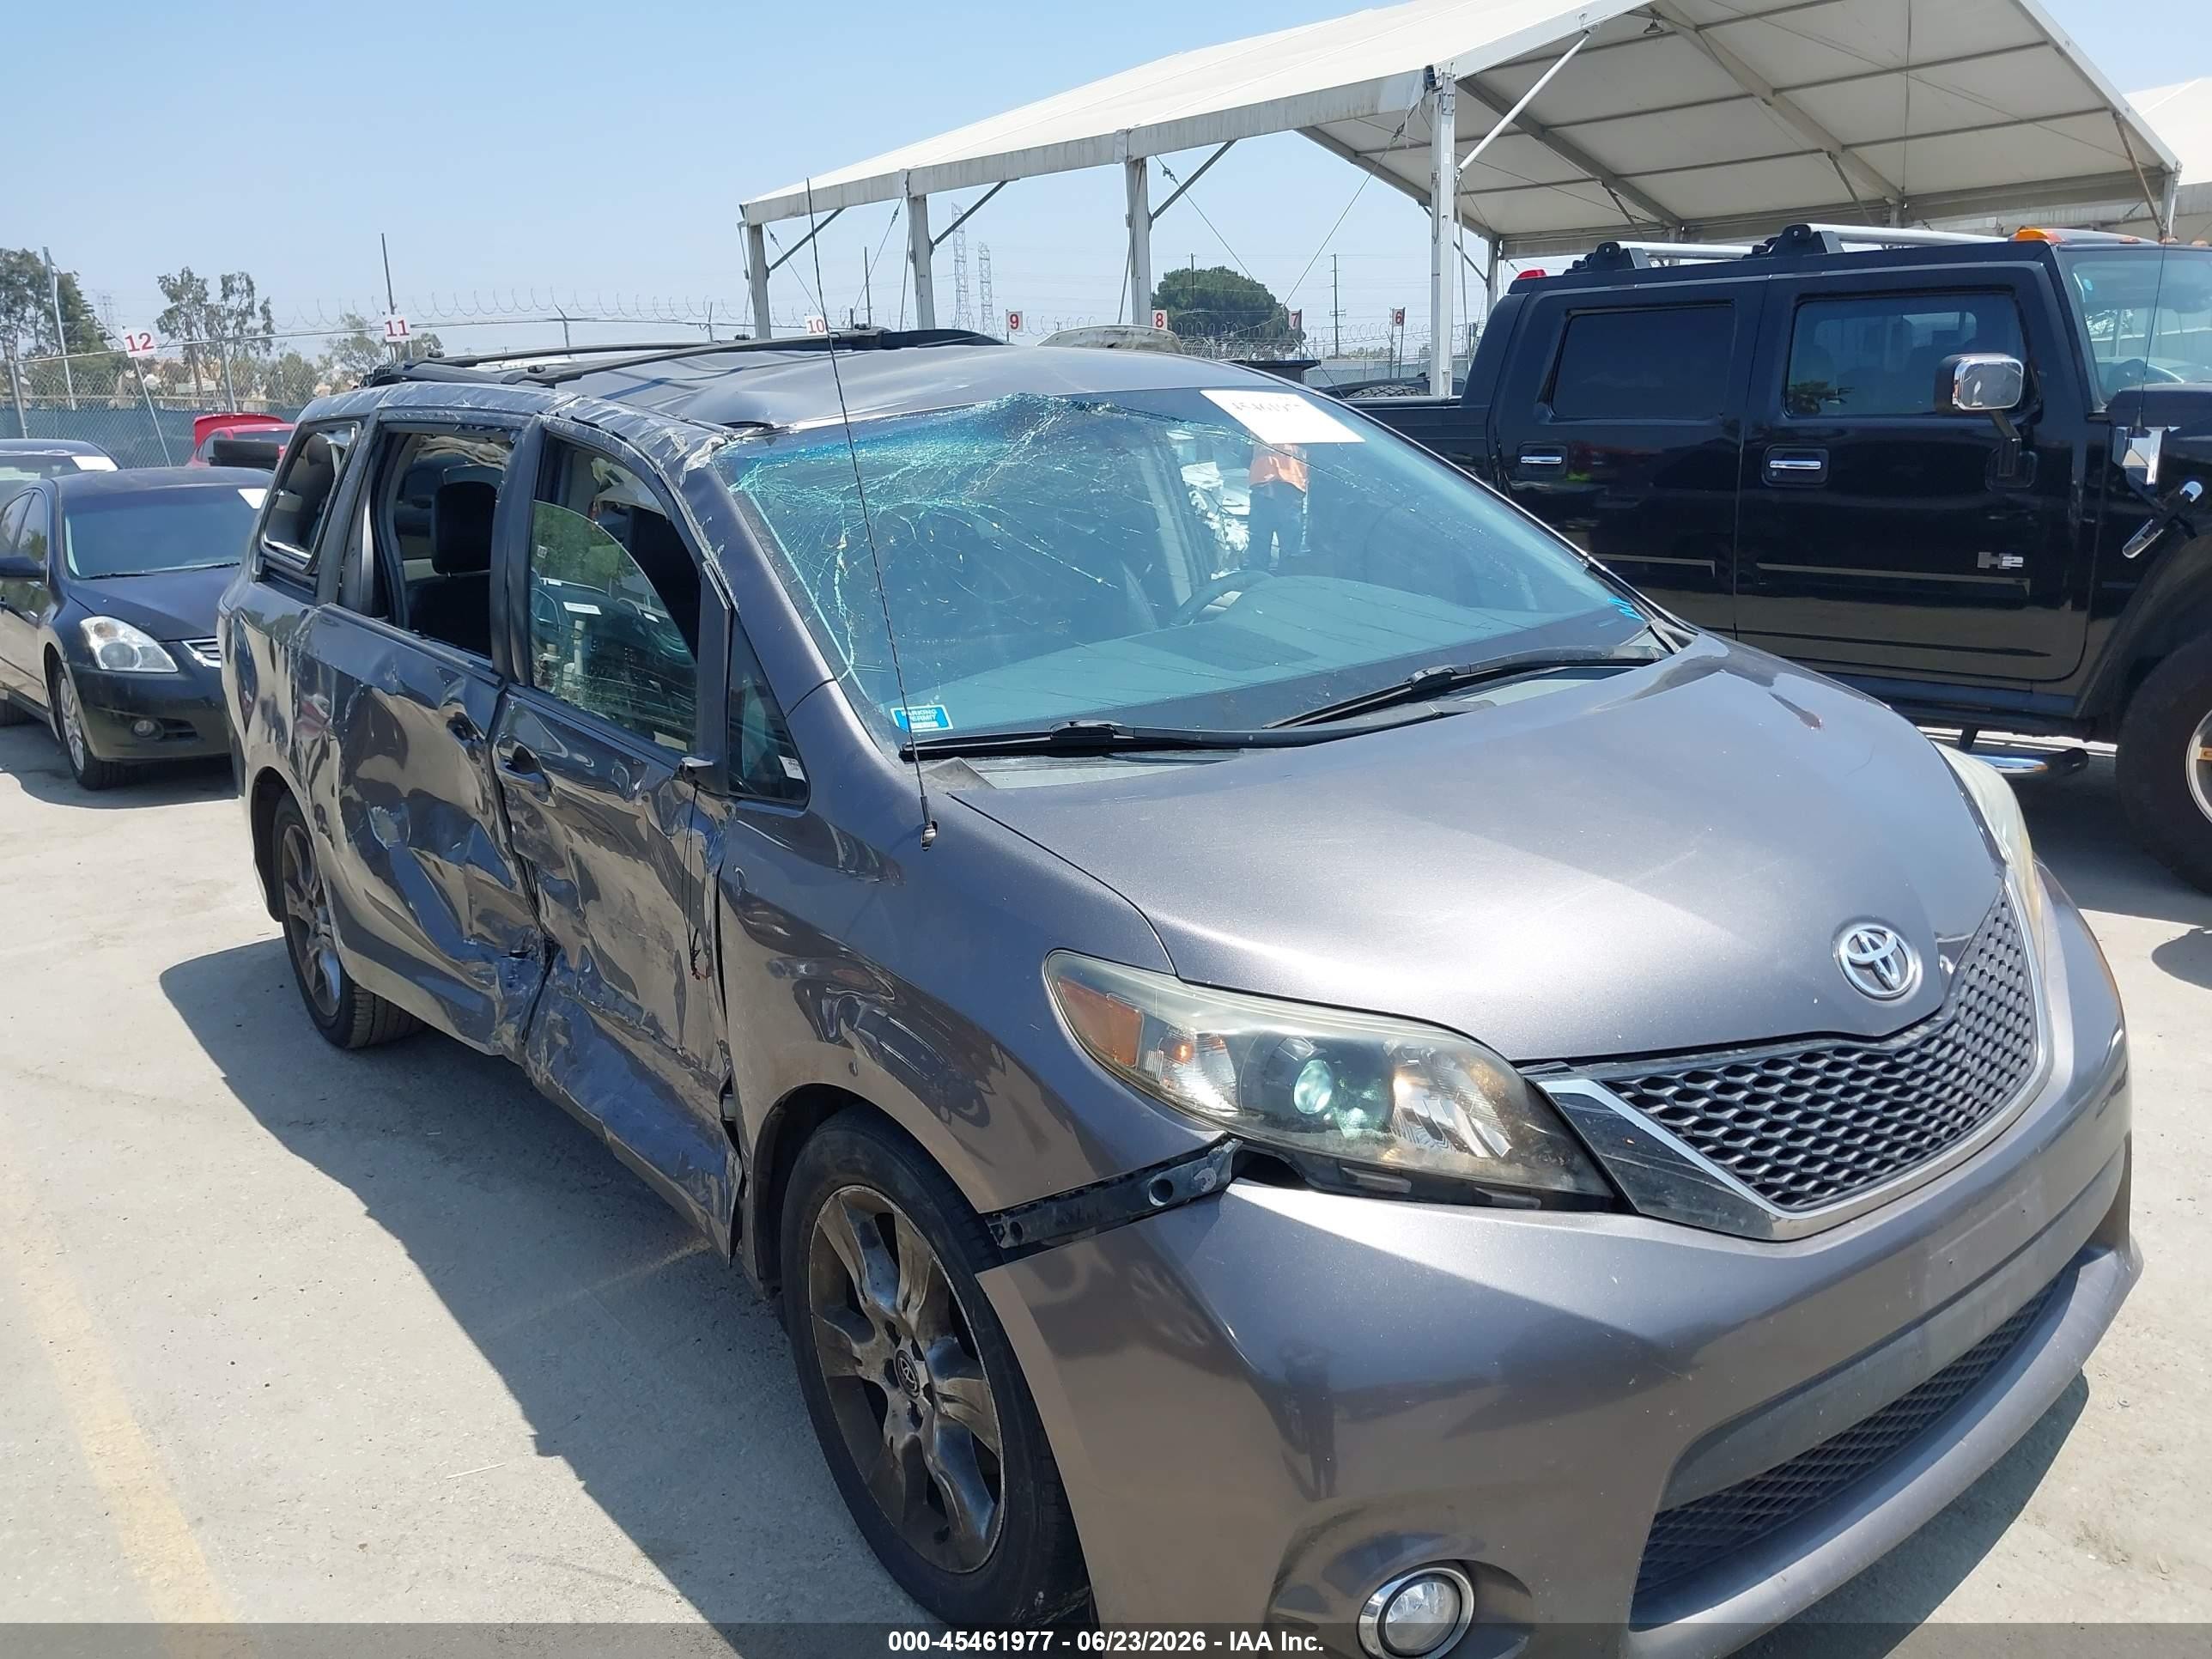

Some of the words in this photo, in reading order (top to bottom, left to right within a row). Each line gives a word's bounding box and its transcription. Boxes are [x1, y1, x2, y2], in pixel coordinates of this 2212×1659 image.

[1010, 313, 1019, 330] 9
[1155, 313, 1164, 328] 8
[1291, 313, 1299, 327] 7
[1395, 311, 1402, 325] 6
[385, 319, 410, 337] 11
[806, 319, 825, 334] 10
[125, 332, 155, 352] 12
[1977, 552, 2023, 569] H2
